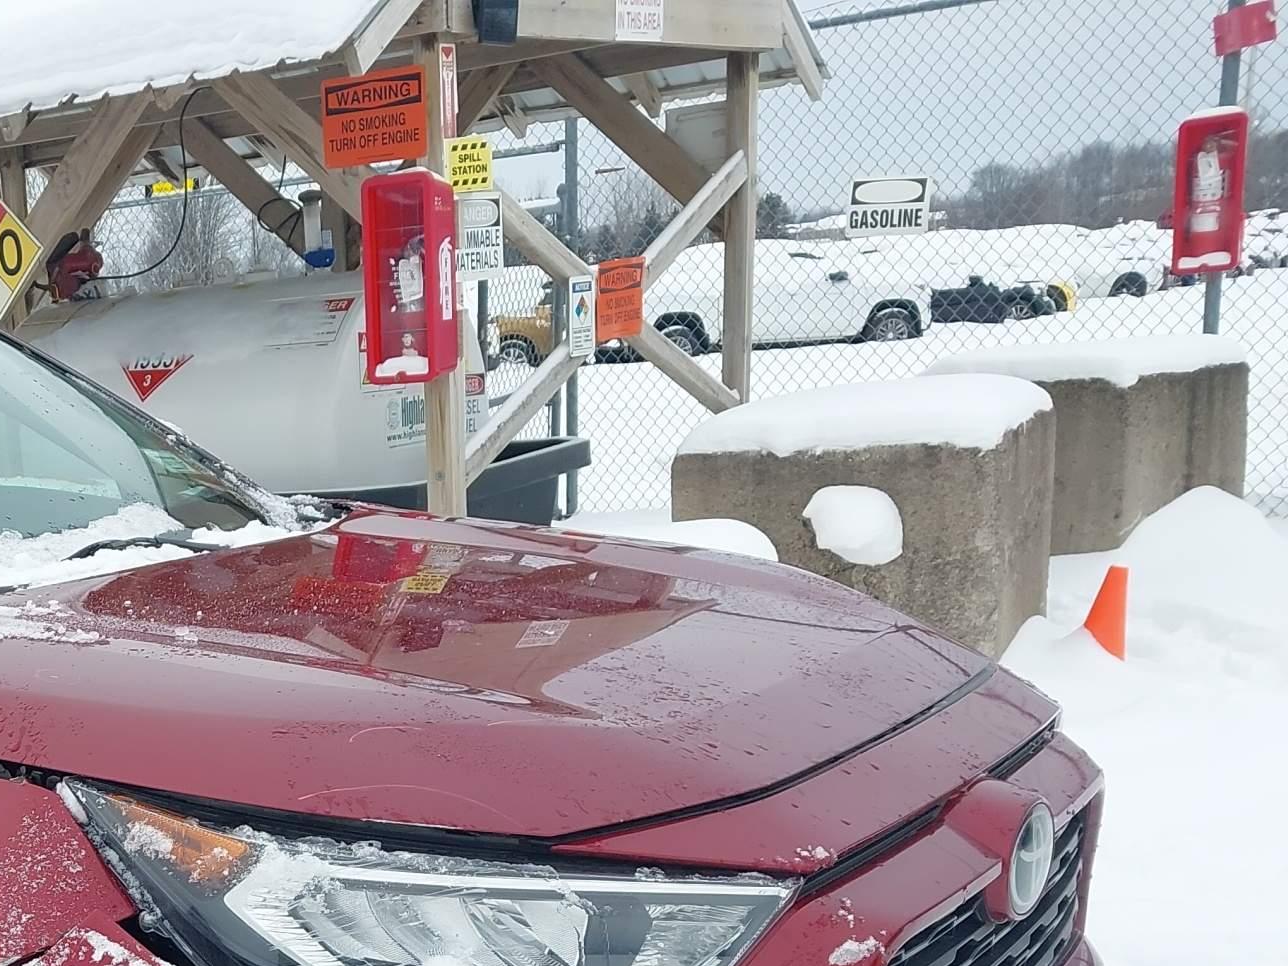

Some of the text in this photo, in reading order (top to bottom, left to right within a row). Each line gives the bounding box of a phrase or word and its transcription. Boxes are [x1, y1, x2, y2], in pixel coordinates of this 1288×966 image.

[626, 11, 642, 29] THIS
[643, 12, 662, 29] AREA
[336, 82, 411, 107] WARNING
[341, 112, 406, 134] NO SMOKING
[329, 128, 420, 152] TURN OFF ENGINE
[458, 152, 482, 163] SPILL
[452, 163, 488, 176] STATION
[849, 208, 923, 229] GASOLINE
[465, 229, 500, 249] MMABLE
[603, 270, 638, 287] WARNING
[143, 374, 152, 387] 3
